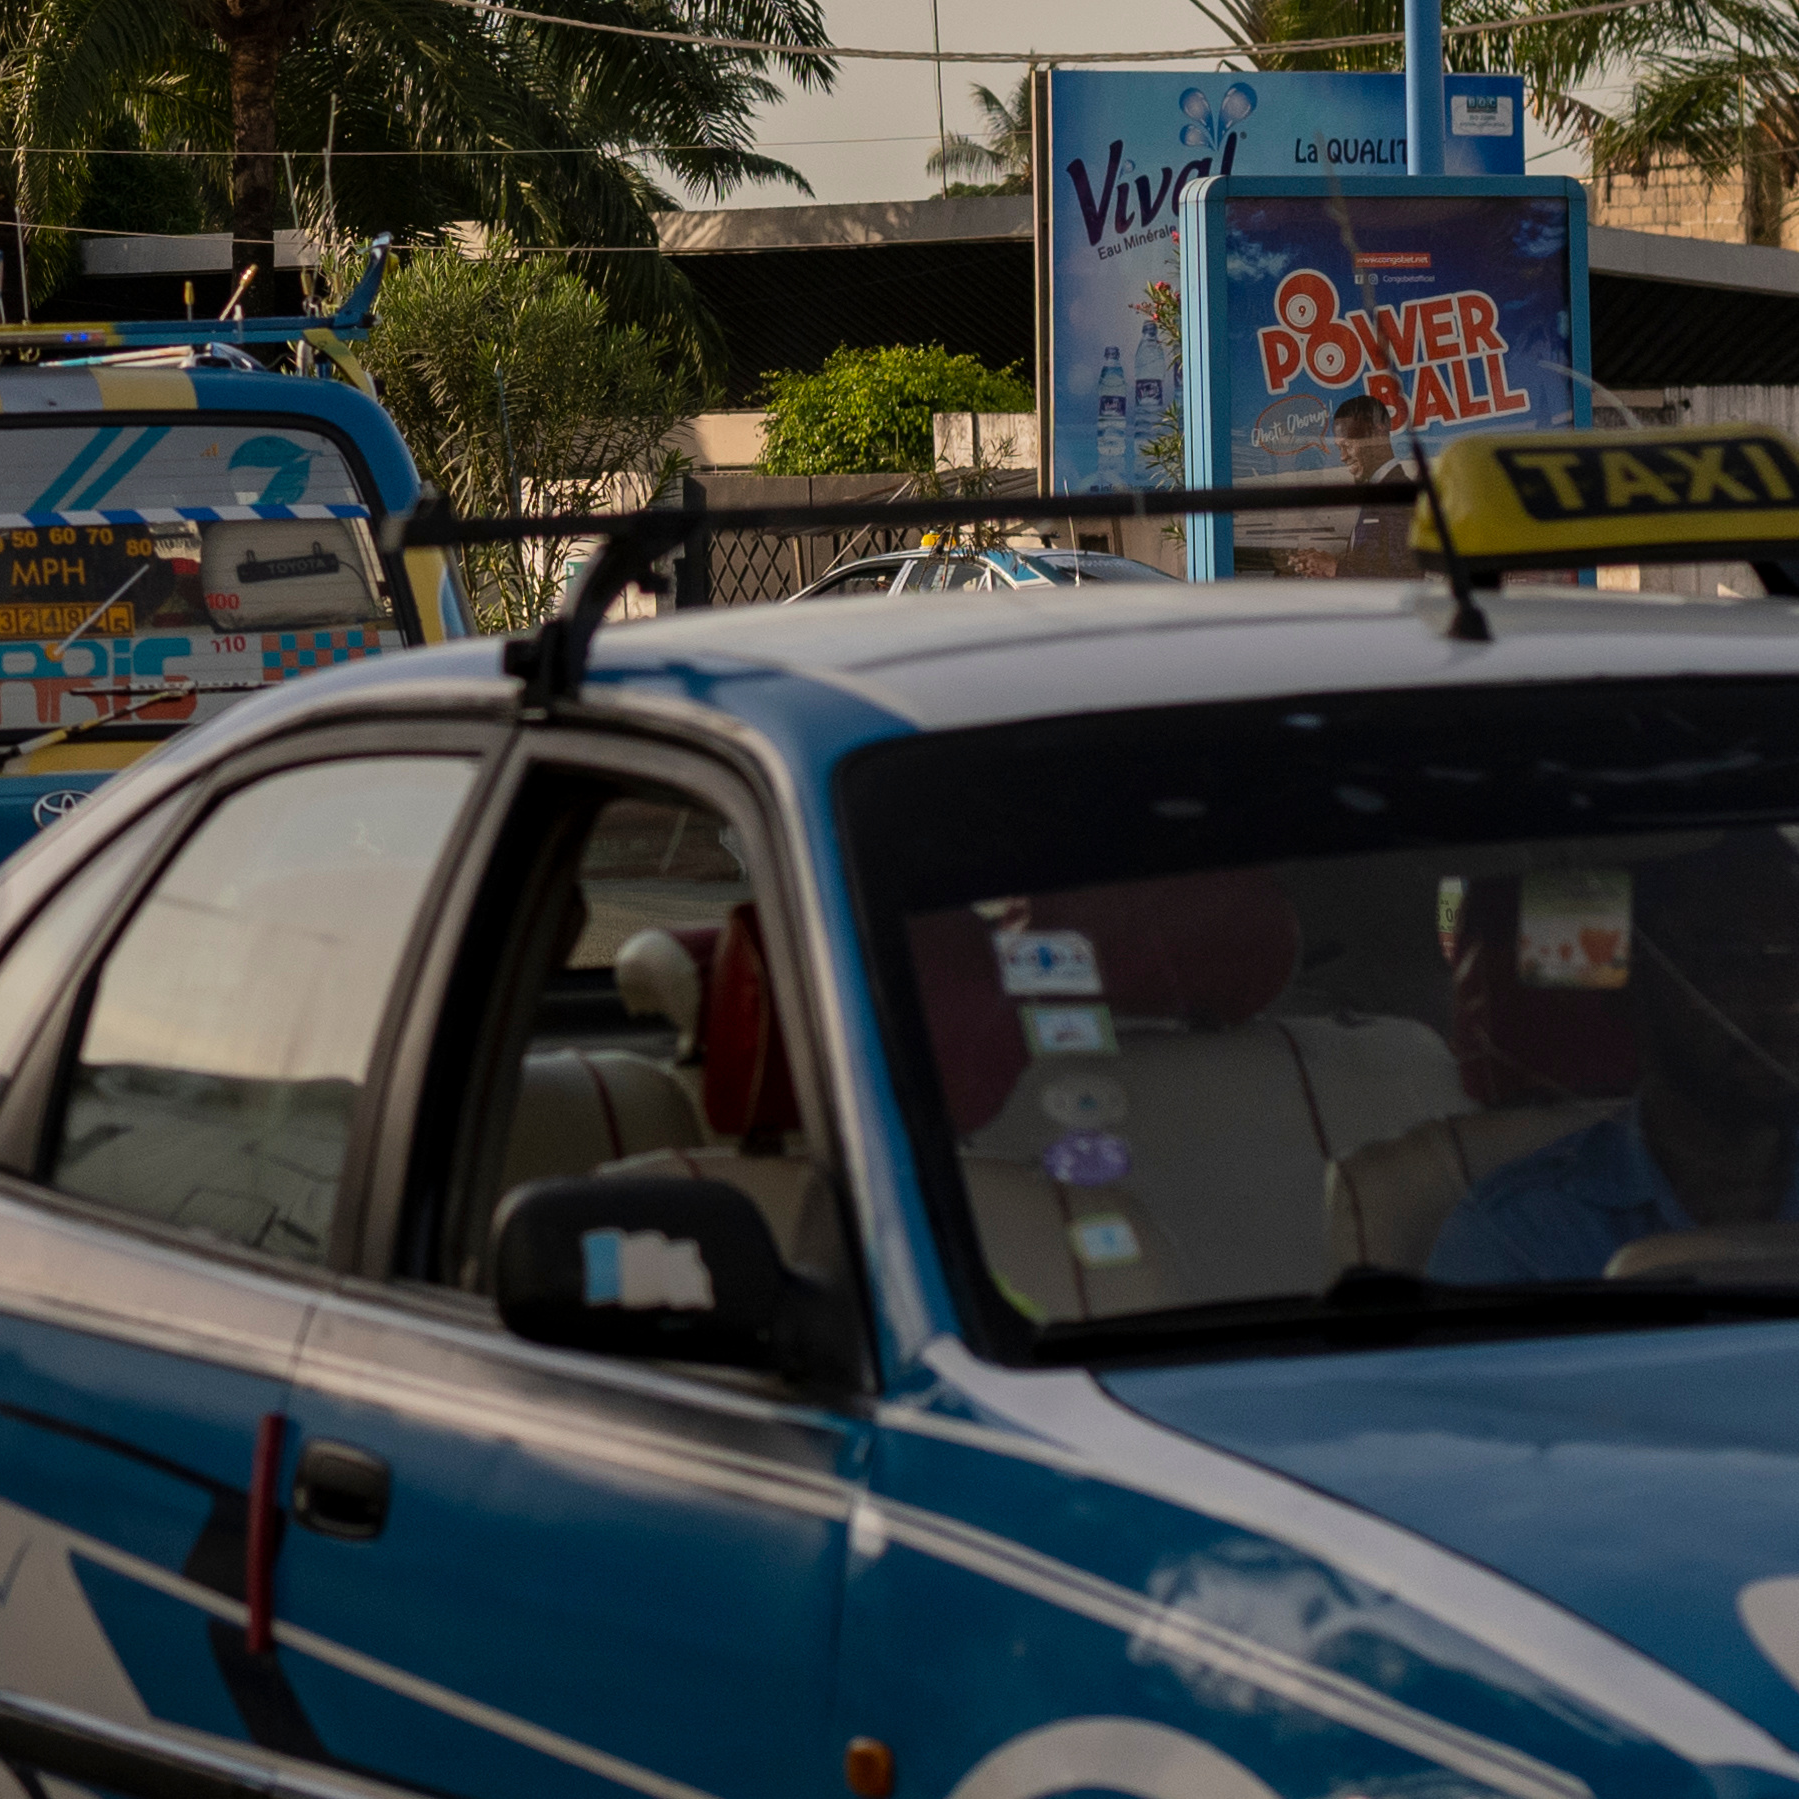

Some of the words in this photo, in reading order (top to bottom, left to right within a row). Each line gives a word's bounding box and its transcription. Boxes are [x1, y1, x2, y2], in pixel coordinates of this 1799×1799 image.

[1295, 138, 1318, 164] La
[1327, 138, 1407, 164] QUALIT
[1097, 243, 1122, 260] Eau
[1260, 271, 1505, 392] POWER
[1366, 353, 1527, 431] BALL
[1513, 444, 1796, 511] TAXI
[11, 530, 38, 549] 50
[50, 527, 76, 545] 60
[86, 527, 114, 545] 70
[125, 538, 152, 556] 80
[11, 558, 86, 586] MPH
[267, 558, 327, 574] TOYOTA
